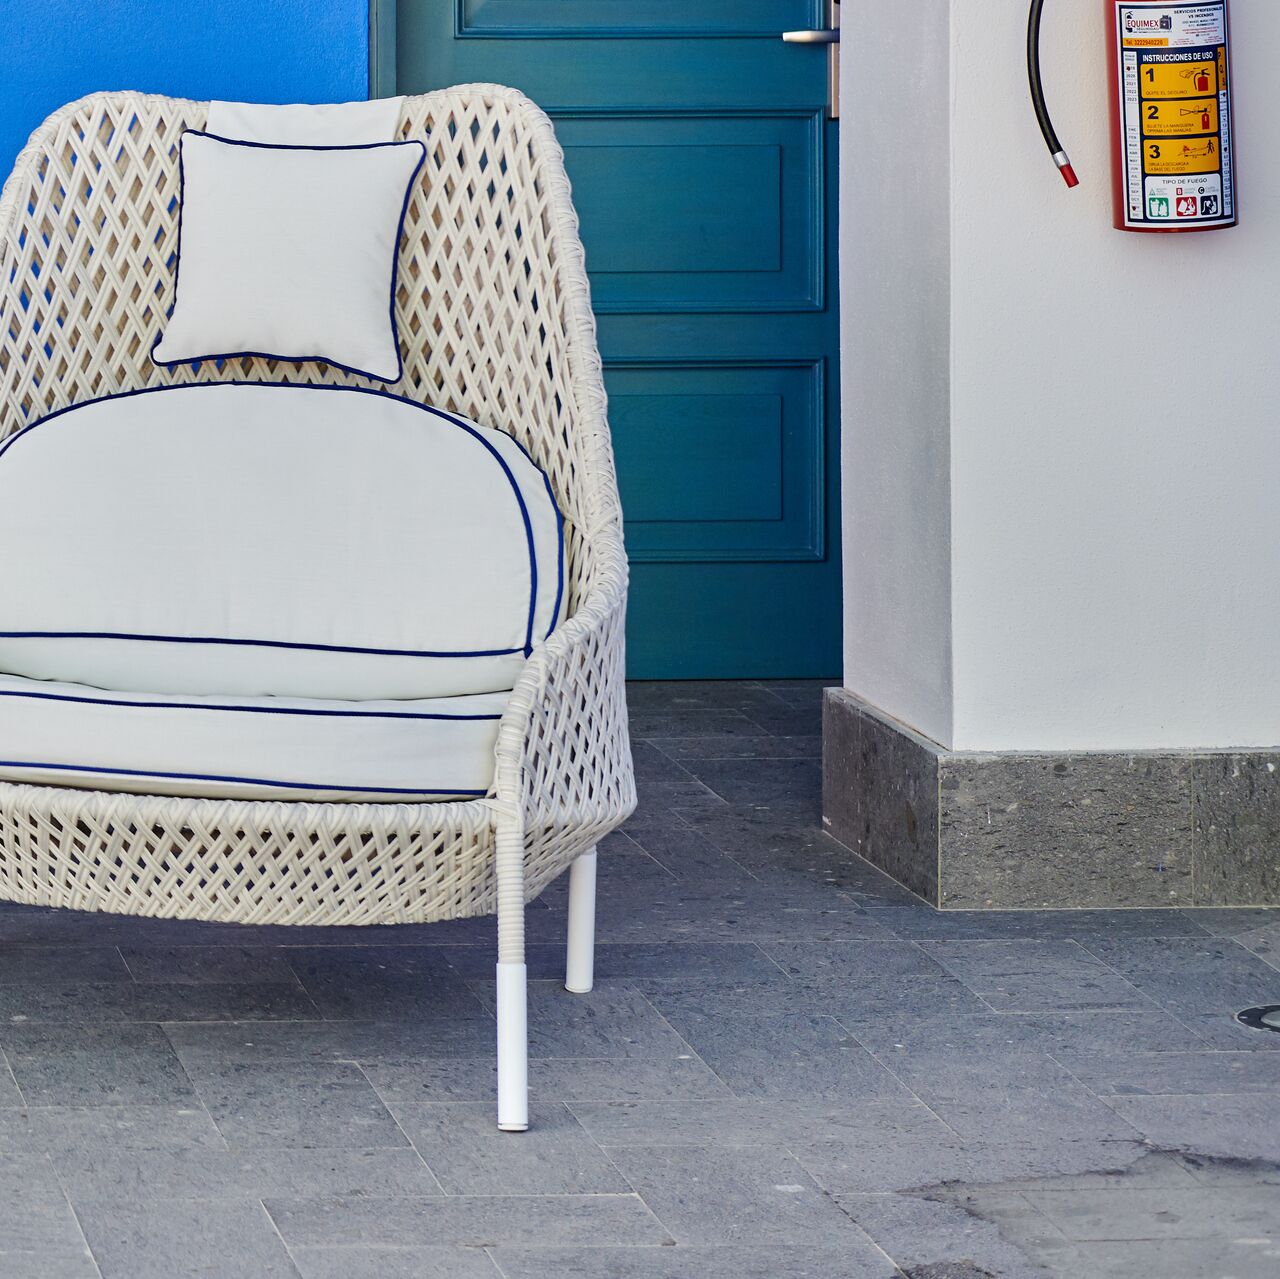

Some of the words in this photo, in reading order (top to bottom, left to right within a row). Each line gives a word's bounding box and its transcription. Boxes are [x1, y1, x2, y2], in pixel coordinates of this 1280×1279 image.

[1127, 19, 1159, 28] EQUIMEX
[1142, 53, 1192, 62] INSTRUCCIONES
[1193, 52, 1201, 60] DE
[1202, 51, 1214, 59] USO
[1145, 67, 1155, 82] 1
[1147, 105, 1159, 120] 2
[1149, 144, 1161, 159] 3
